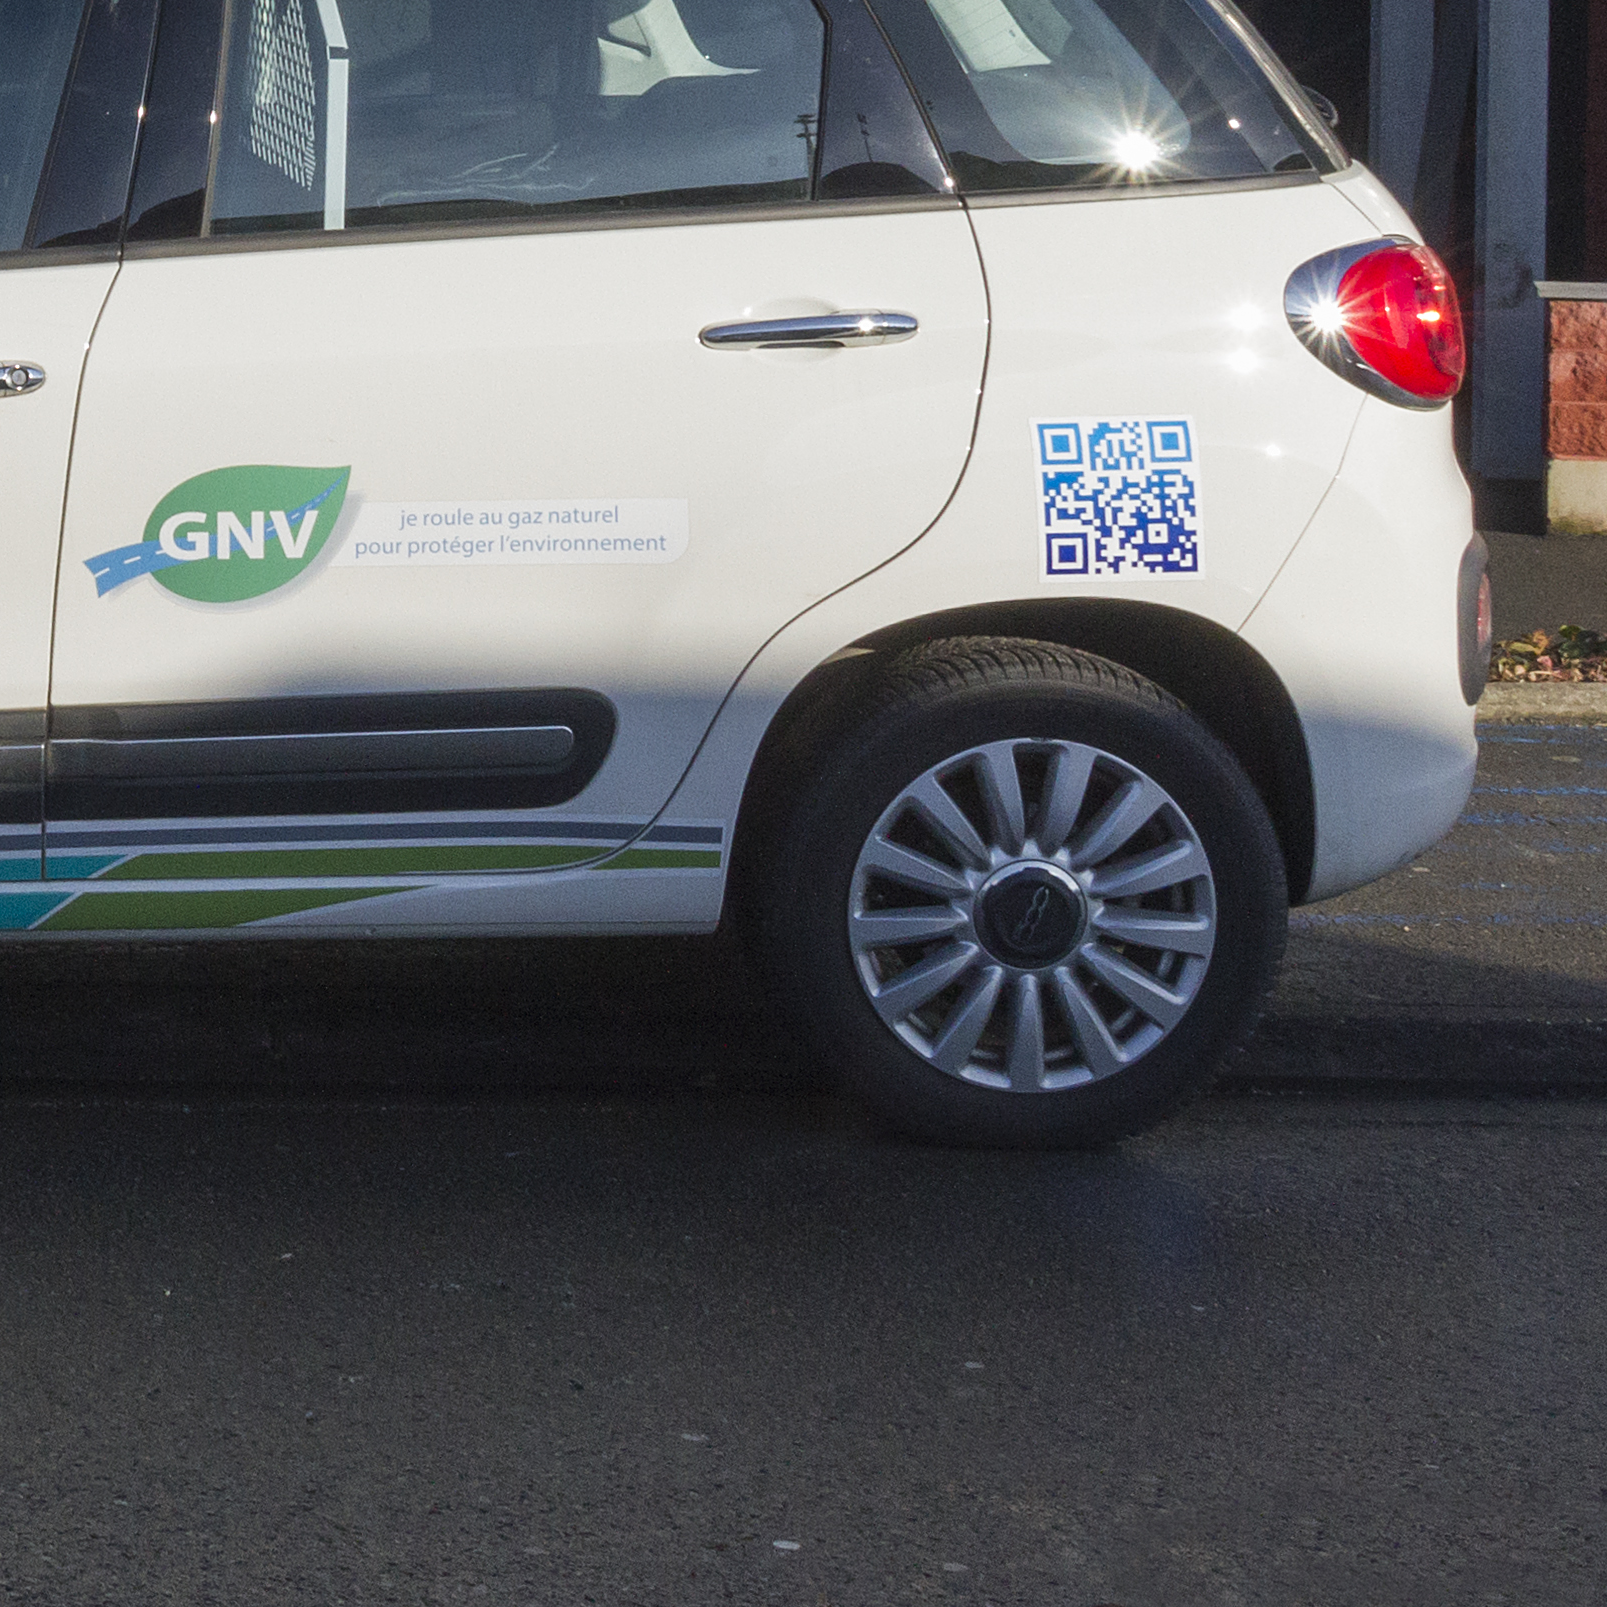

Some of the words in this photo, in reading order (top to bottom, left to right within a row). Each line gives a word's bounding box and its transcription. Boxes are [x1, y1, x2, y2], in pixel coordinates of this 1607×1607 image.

[399, 508, 418, 531] je
[422, 507, 474, 527] roule
[478, 512, 503, 527] au
[508, 511, 543, 531] gaz
[548, 505, 620, 525] naturel
[158, 510, 319, 562] GNV
[354, 537, 403, 560] pour
[407, 534, 495, 560] protéger
[500, 533, 667, 554] l'environnement
